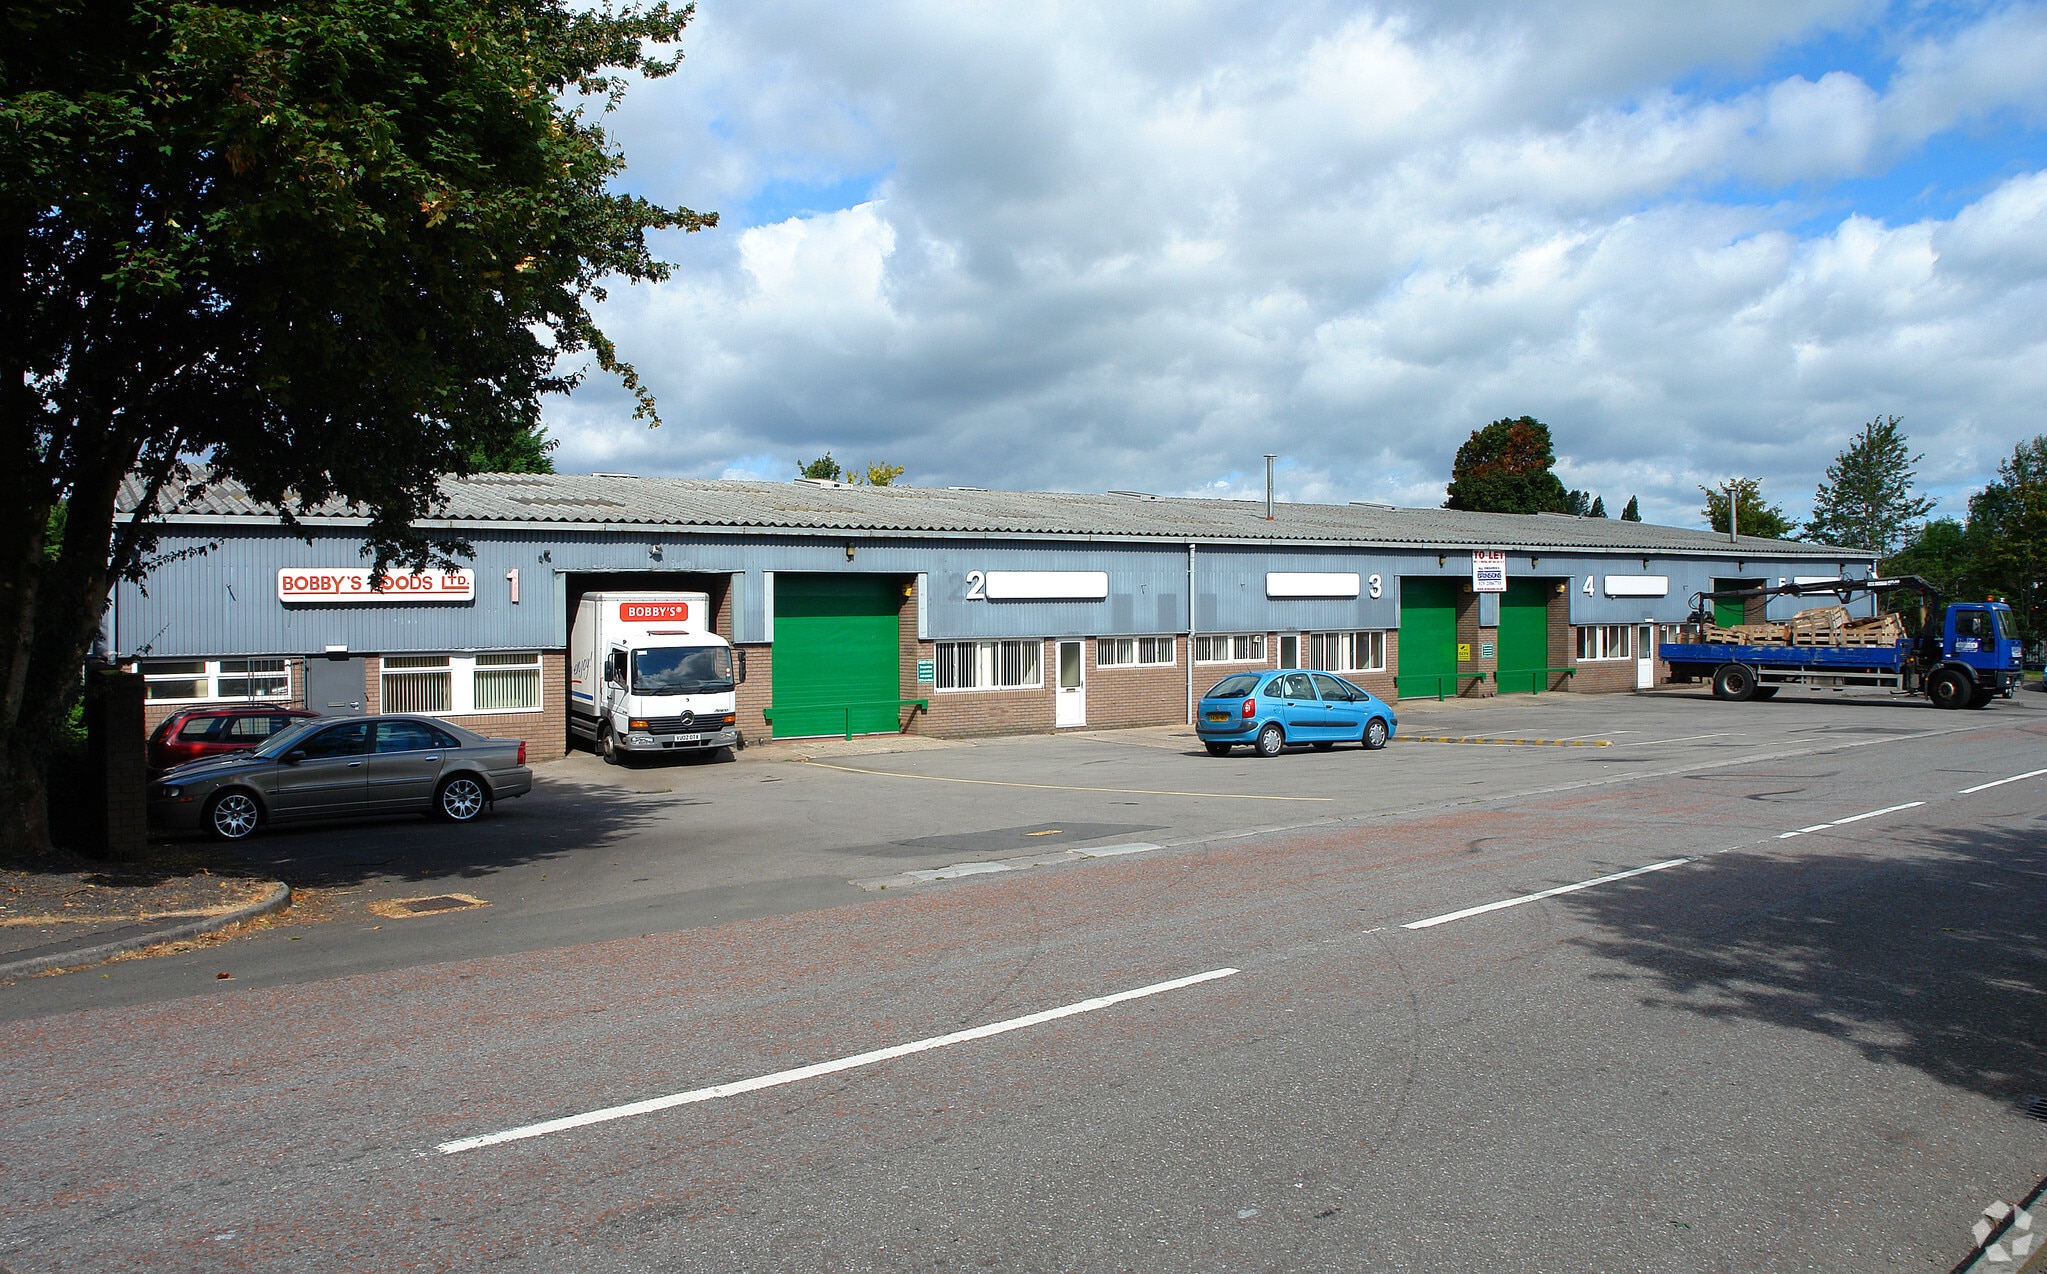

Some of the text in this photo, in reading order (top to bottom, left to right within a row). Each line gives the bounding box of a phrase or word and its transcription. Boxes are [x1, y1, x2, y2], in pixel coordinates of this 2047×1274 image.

[1473, 551, 1505, 559] TO LET
[282, 576, 362, 594] BOBBY'S
[370, 575, 433, 590] OODS
[506, 568, 519, 602] 1
[966, 570, 985, 599] 2
[1368, 574, 1382, 599] 3
[1583, 575, 1595, 597] 4
